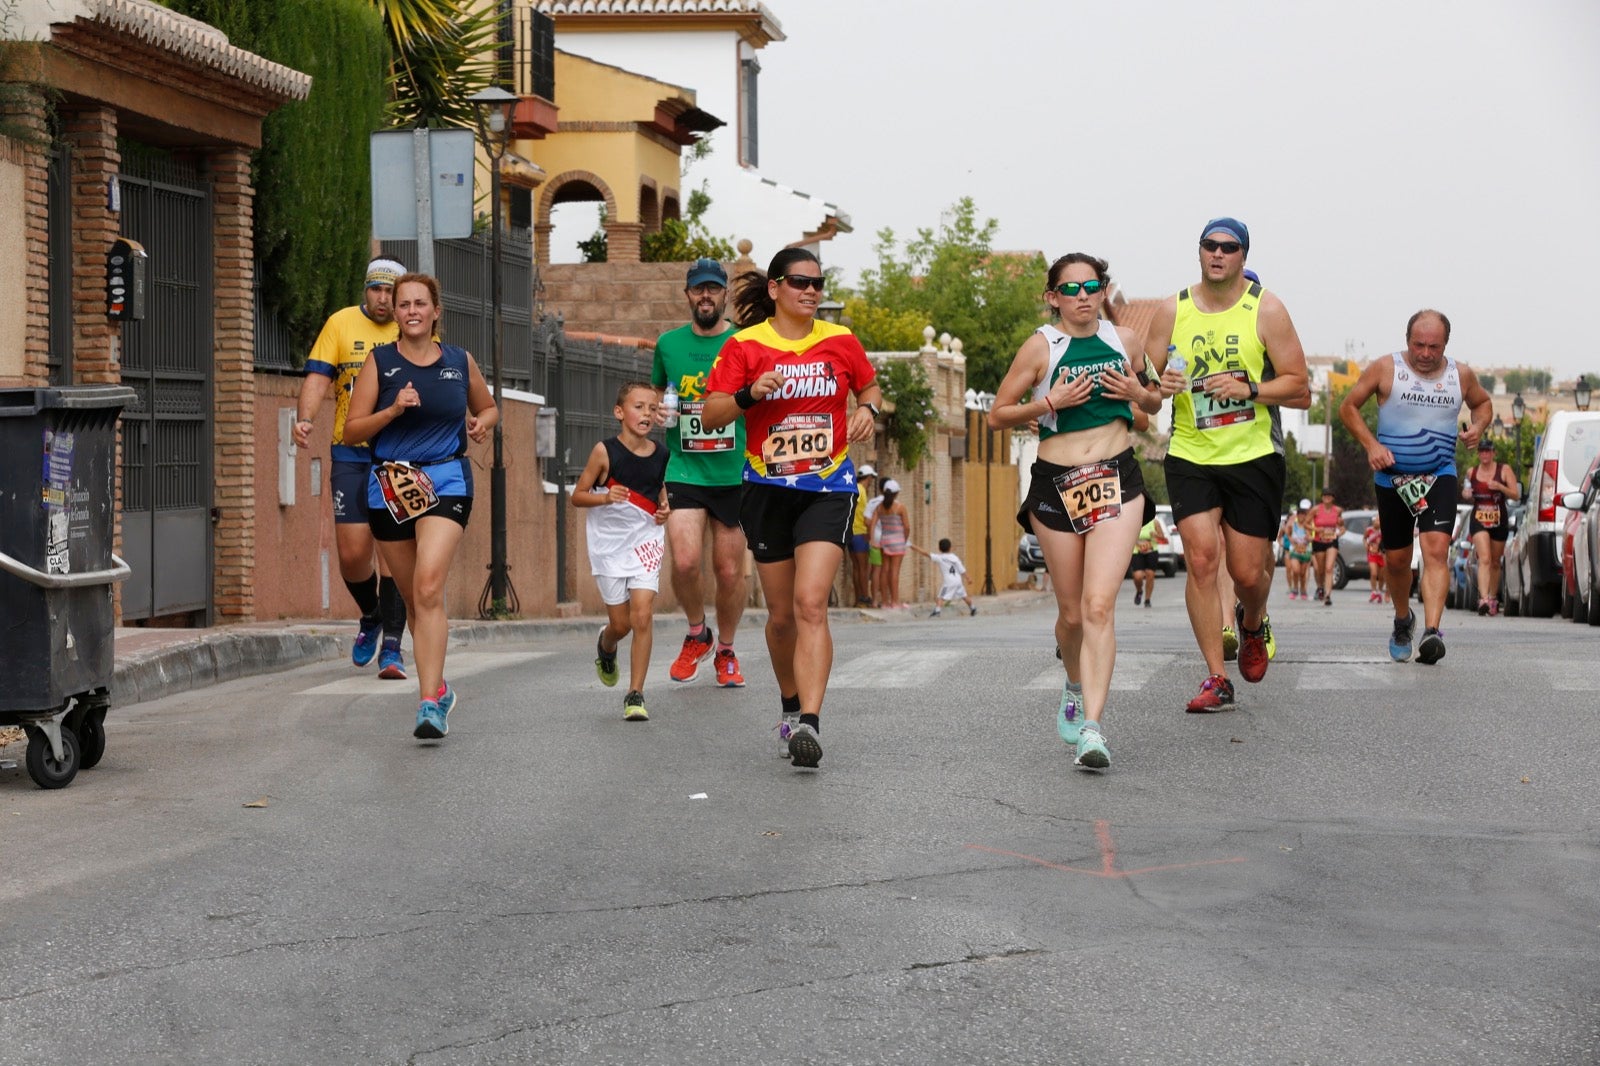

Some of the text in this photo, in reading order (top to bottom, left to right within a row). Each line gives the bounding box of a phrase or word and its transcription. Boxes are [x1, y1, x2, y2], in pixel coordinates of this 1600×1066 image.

[775, 361, 825, 378] RUNNER
[1400, 392, 1455, 405] MARACENA
[772, 433, 828, 457] 2180
[394, 463, 427, 511] 2185
[949, 565, 956, 576] 4
